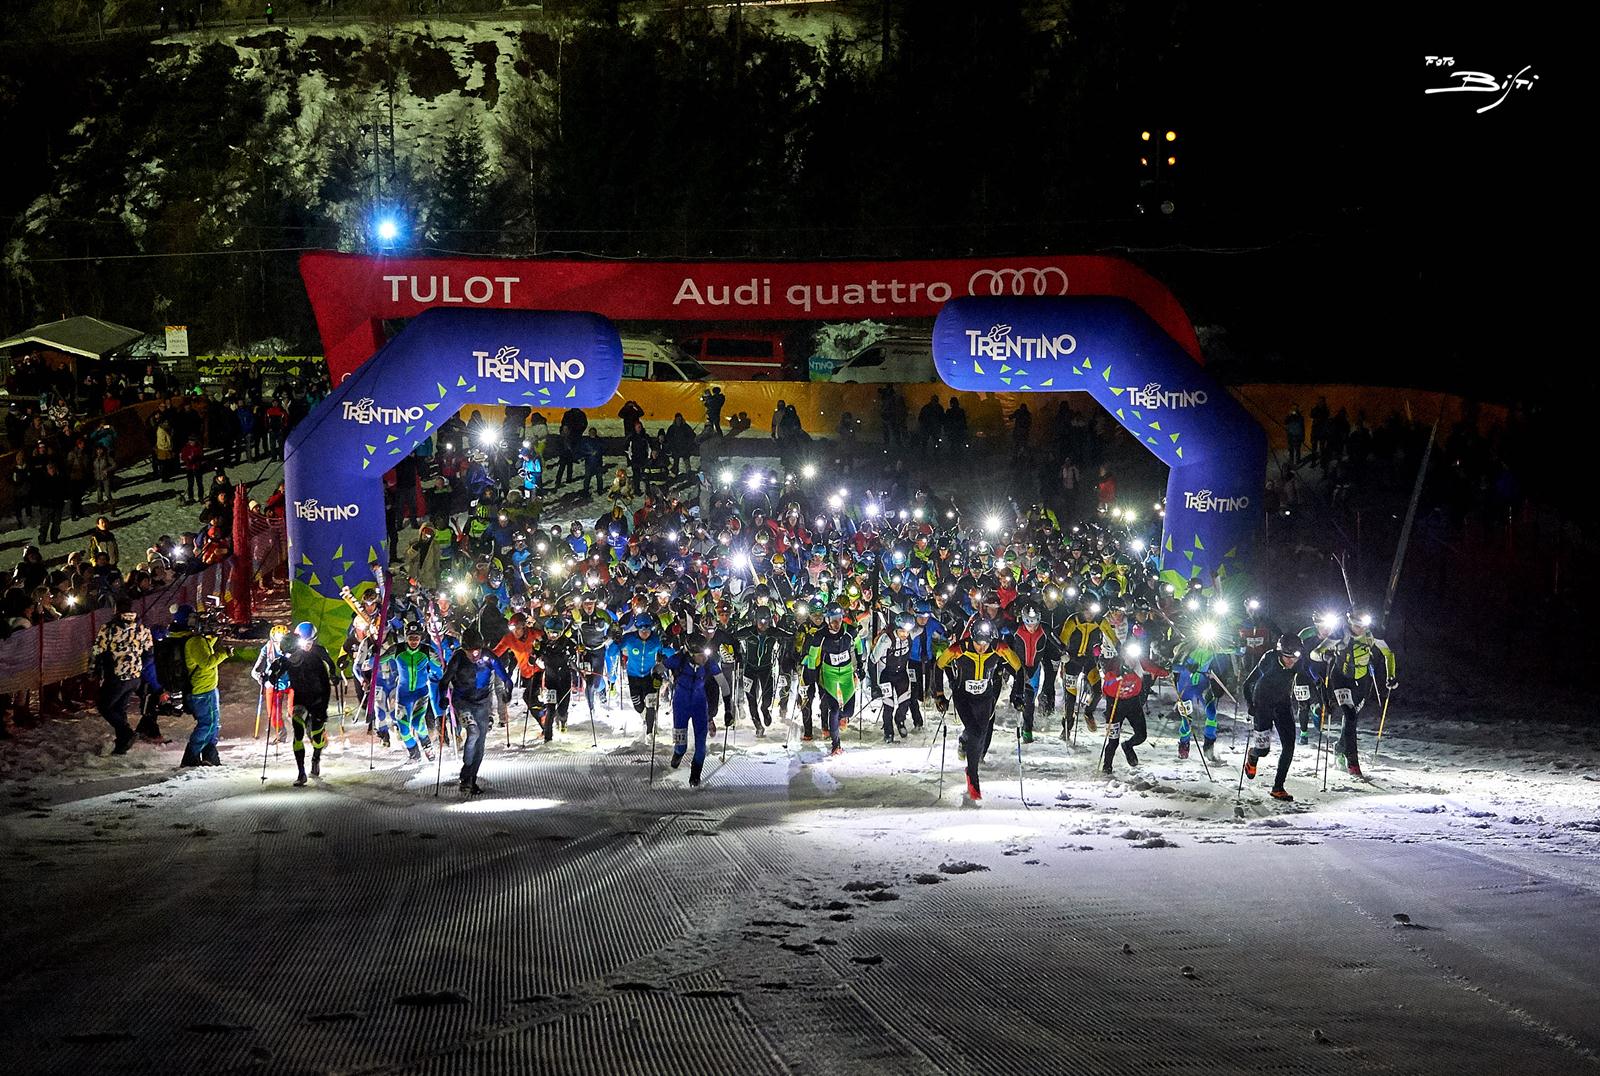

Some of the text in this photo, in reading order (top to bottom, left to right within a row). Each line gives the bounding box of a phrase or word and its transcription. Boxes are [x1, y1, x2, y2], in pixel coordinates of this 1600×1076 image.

[383, 275, 521, 304] TULOT
[672, 277, 953, 312] Audi quattro
[966, 329, 1077, 362] TRENTINO
[472, 350, 586, 384] TRENTINO
[1126, 386, 1209, 410] TRENTINO
[342, 401, 425, 426] TRENTINO
[294, 501, 360, 522] TRENTINO
[1184, 491, 1249, 513] TRENTINO
